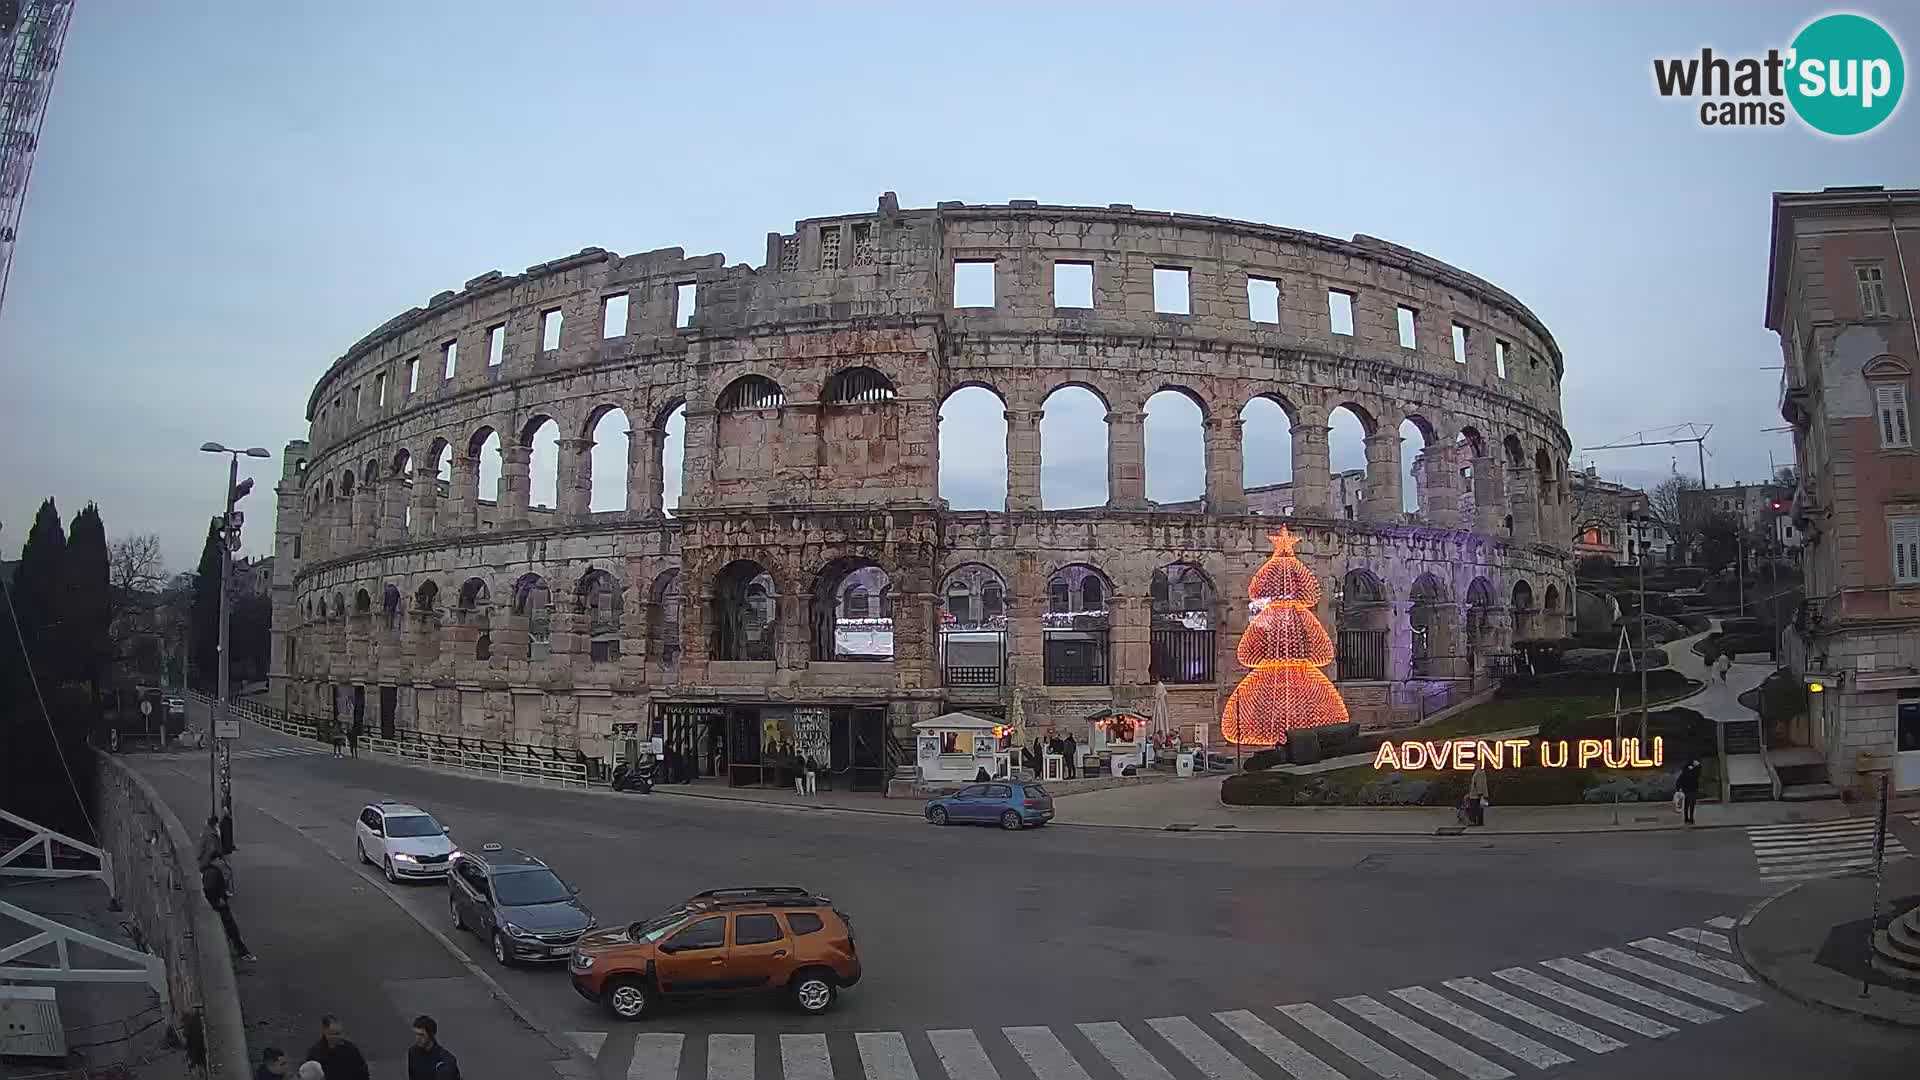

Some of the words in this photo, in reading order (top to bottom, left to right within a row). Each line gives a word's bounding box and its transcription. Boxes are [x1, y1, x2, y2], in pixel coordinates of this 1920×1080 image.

[1374, 739, 1530, 770] ADVENT
[1541, 740, 1568, 768] U
[1578, 736, 1663, 769] PULI
